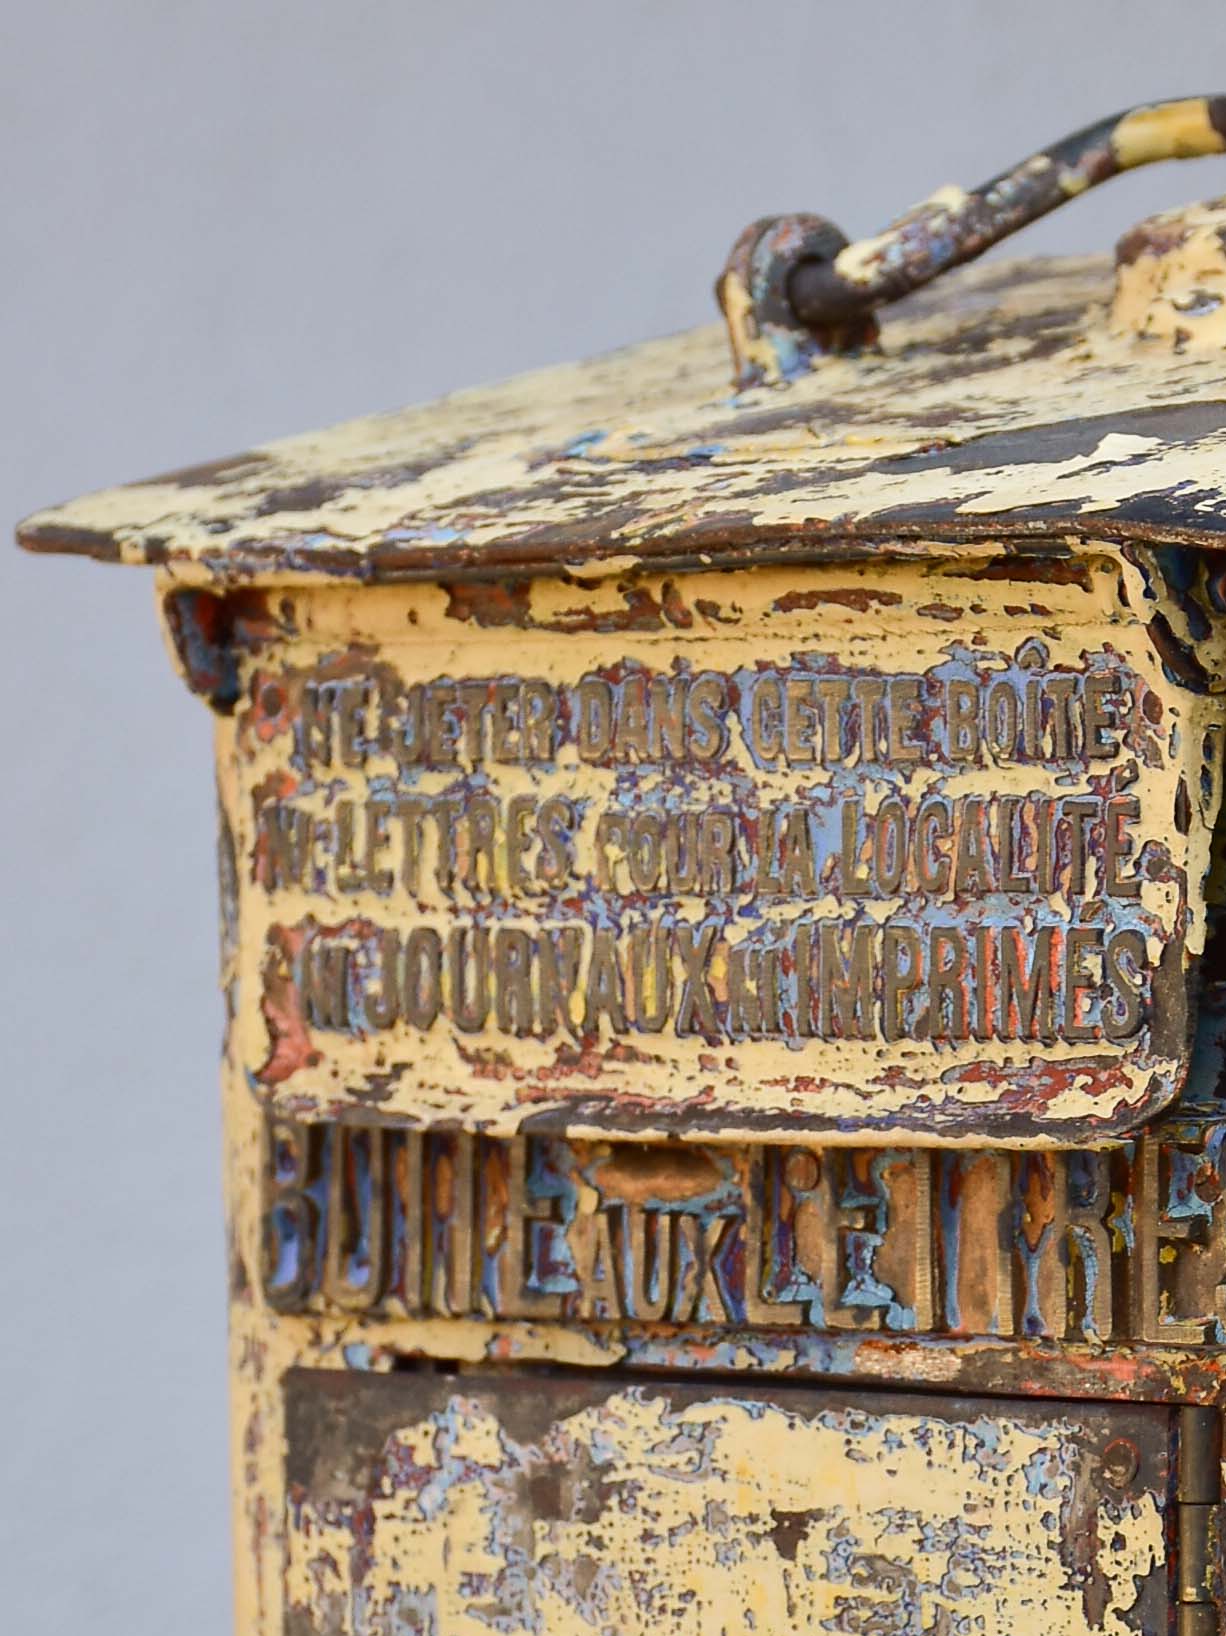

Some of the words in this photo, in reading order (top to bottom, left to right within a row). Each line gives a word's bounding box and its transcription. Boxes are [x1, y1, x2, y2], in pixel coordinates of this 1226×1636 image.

[397, 680, 556, 768] JETER
[576, 676, 726, 762] DANS
[751, 677, 927, 763] CETTE
[335, 797, 578, 900] LETTRES
[598, 811, 735, 897] POUR
[757, 804, 818, 896] LA
[362, 925, 733, 1042] JOURNAUX
[727, 948, 780, 1040] NI
[577, 1206, 748, 1324] AUX
